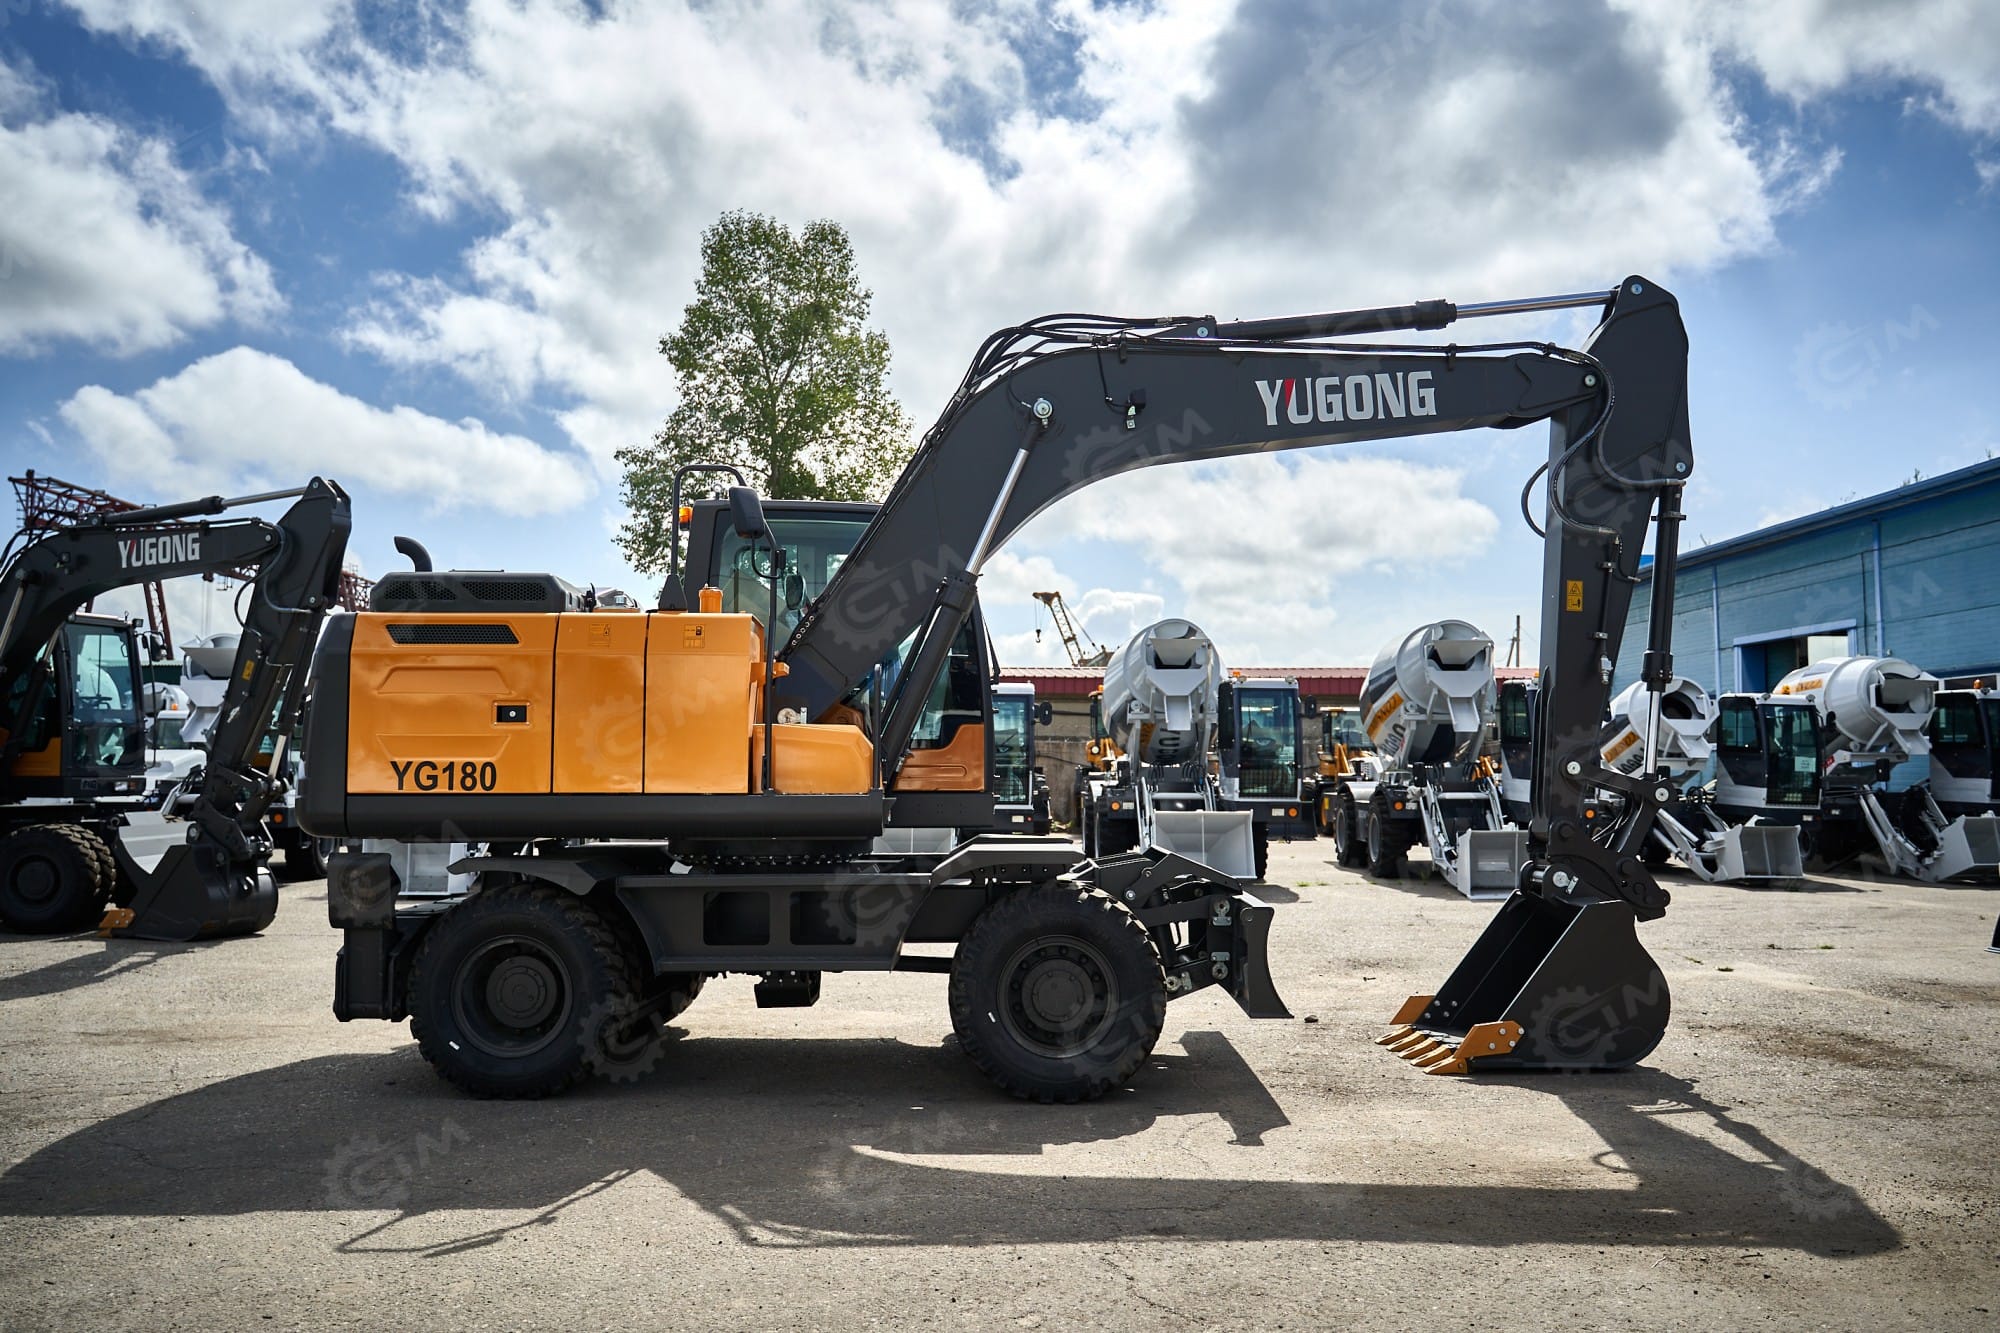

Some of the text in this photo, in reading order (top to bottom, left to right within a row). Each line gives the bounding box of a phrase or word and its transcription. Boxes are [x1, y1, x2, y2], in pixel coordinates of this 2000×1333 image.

[1254, 369, 1438, 427] YUGONG
[117, 531, 202, 569] YUGONG
[389, 760, 498, 793] YG180
